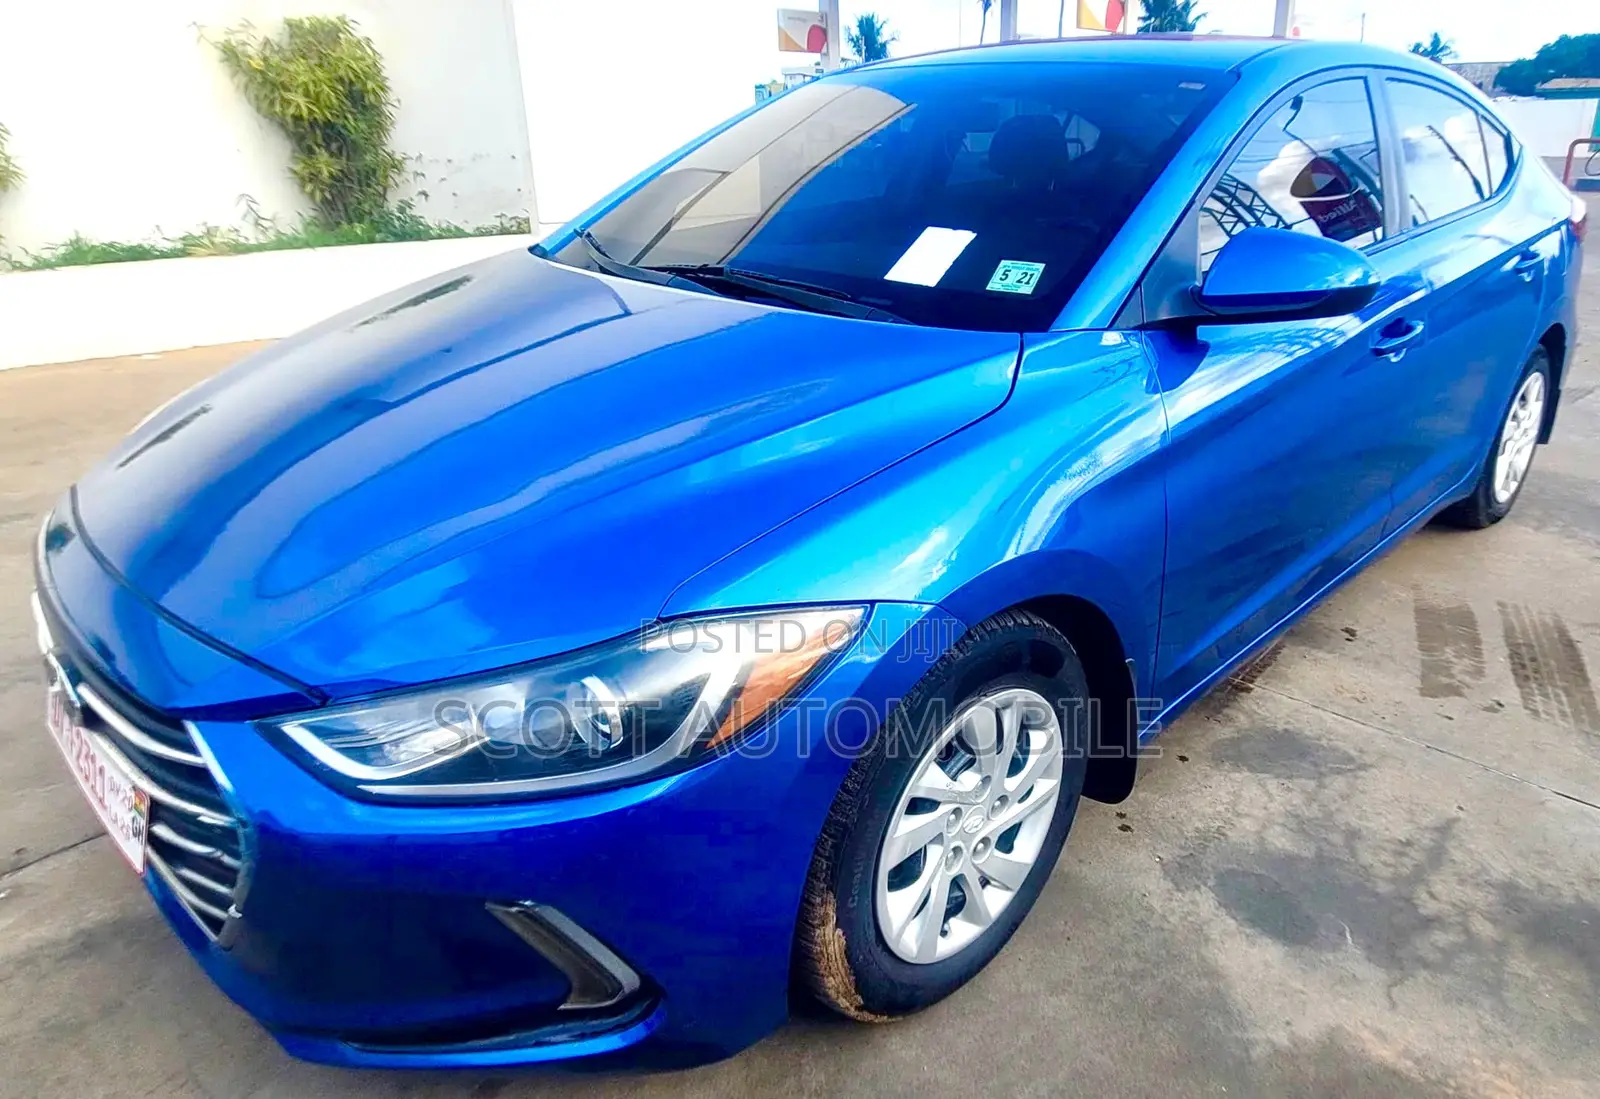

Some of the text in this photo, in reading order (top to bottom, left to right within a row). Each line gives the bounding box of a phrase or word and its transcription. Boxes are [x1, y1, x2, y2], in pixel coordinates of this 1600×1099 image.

[999, 269, 1035, 285] 5 21
[132, 815, 145, 846] GH
